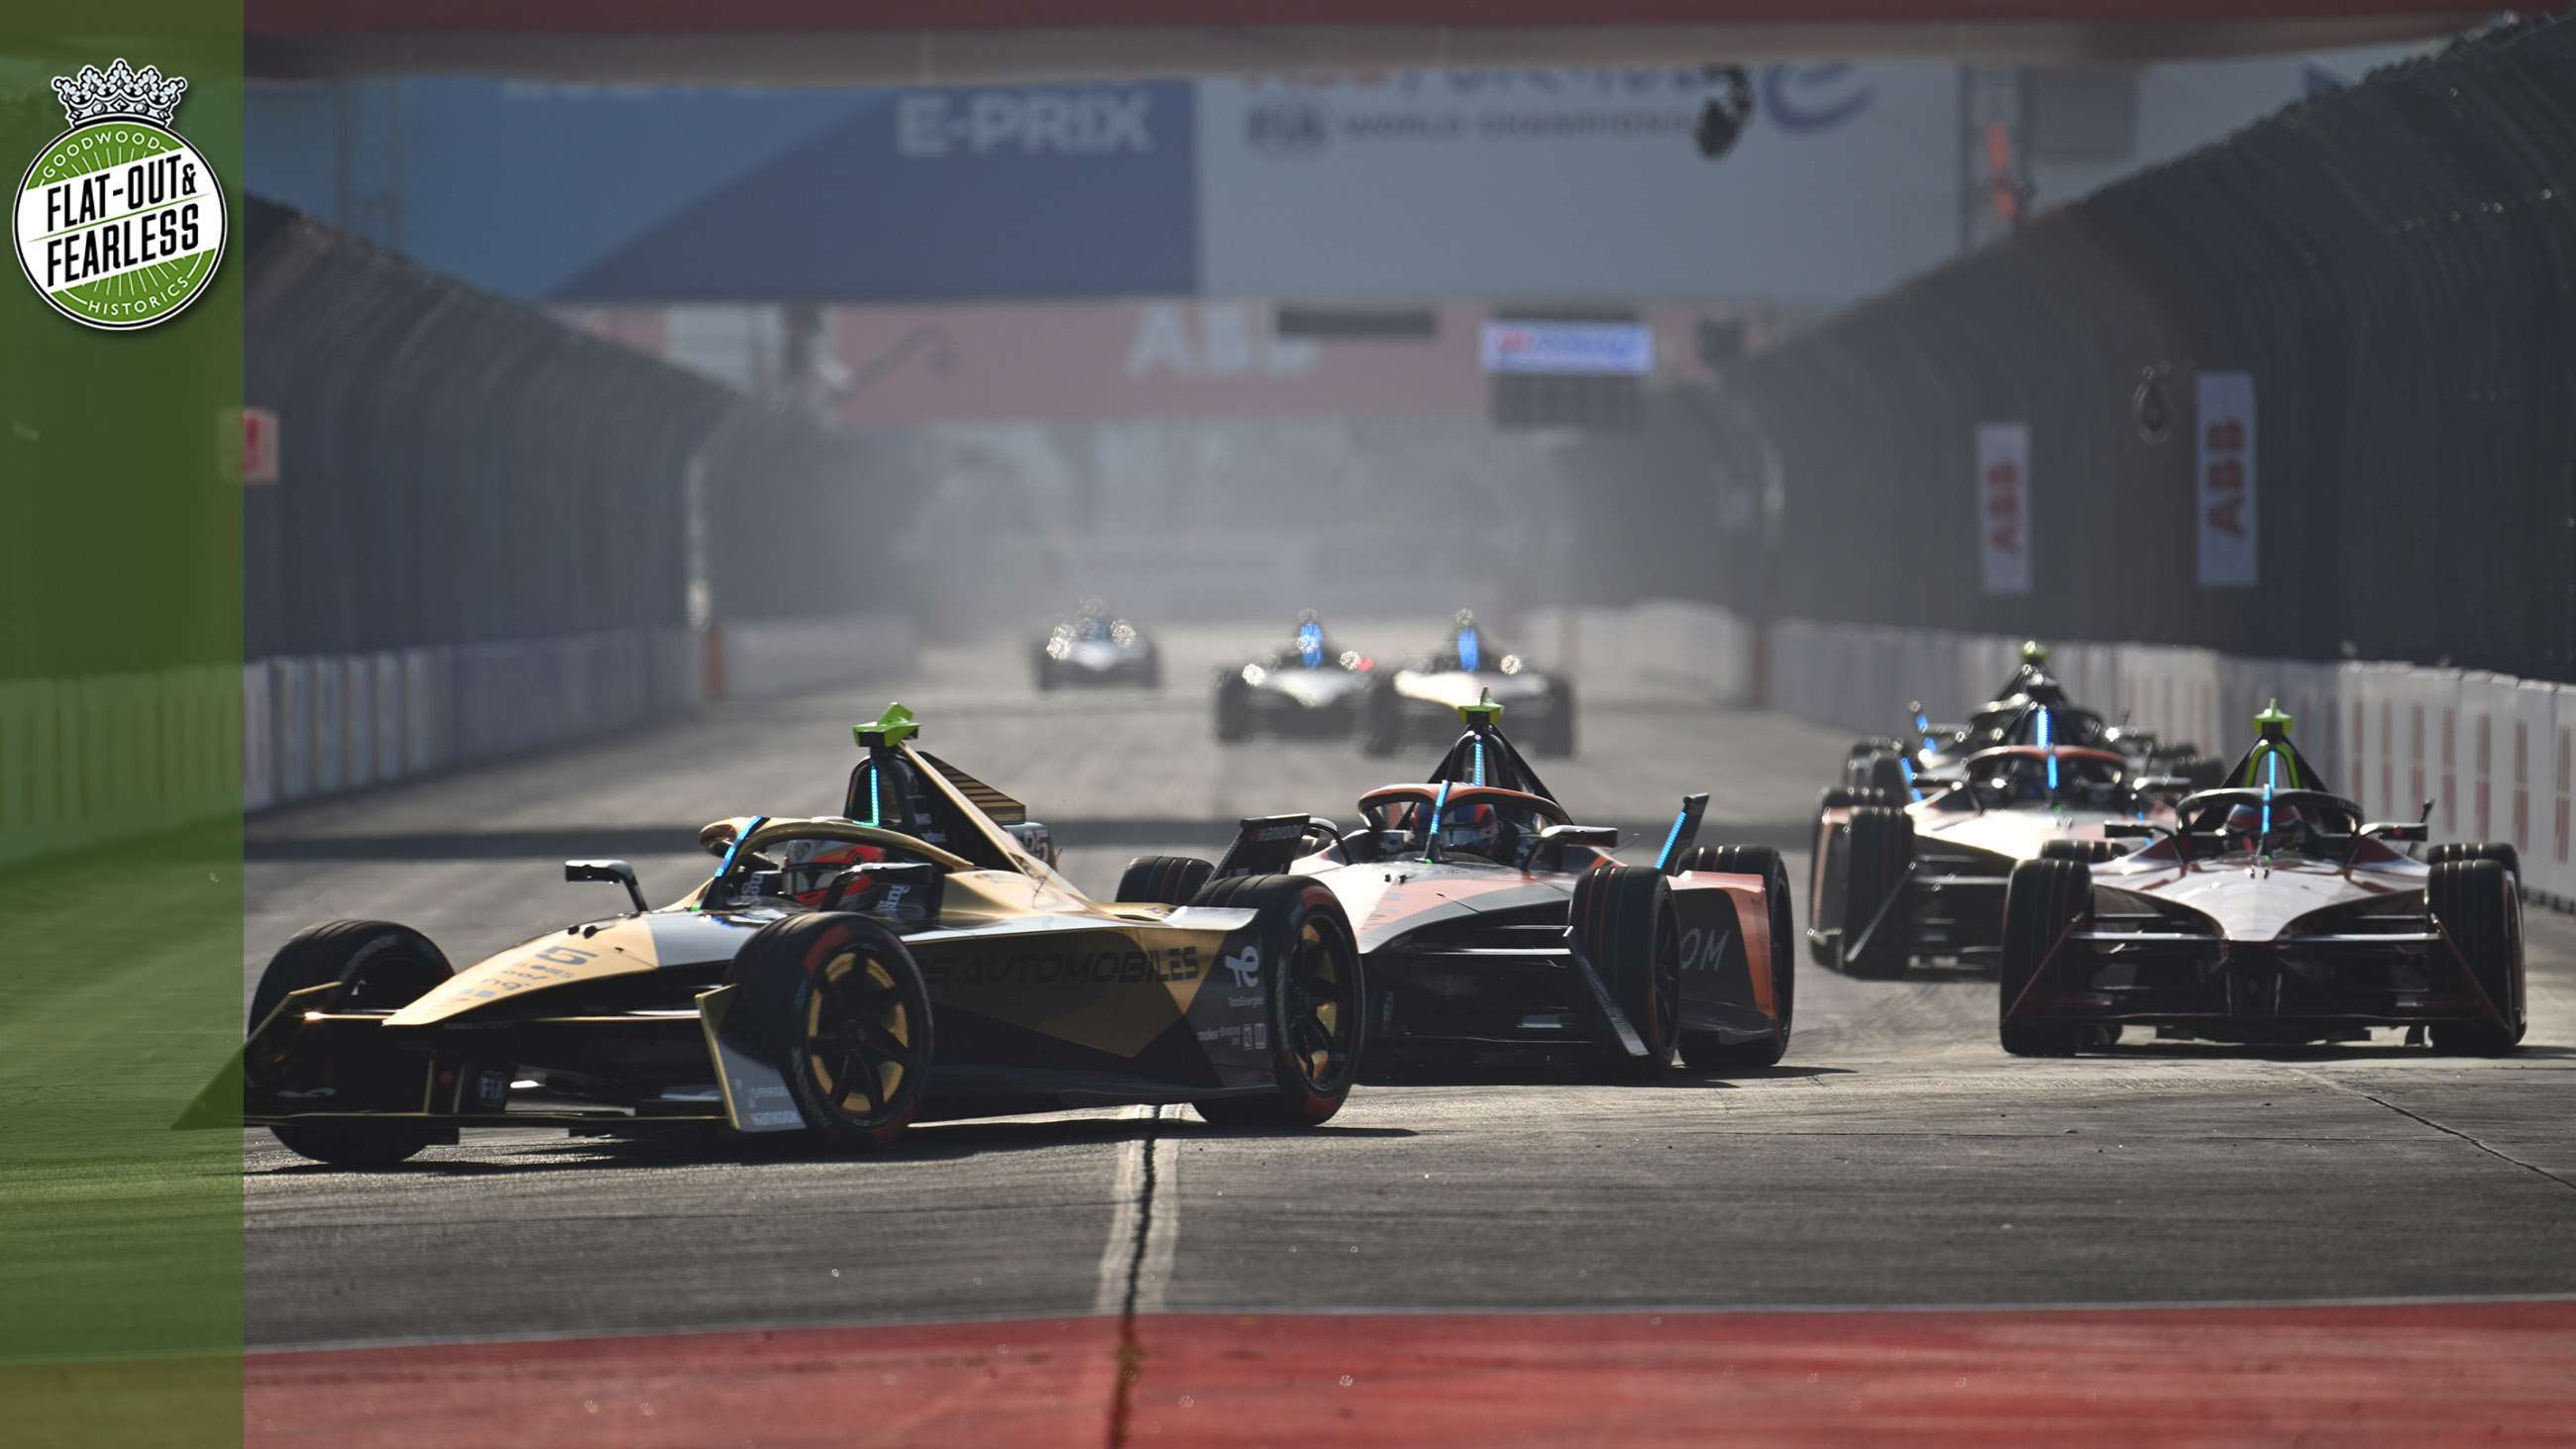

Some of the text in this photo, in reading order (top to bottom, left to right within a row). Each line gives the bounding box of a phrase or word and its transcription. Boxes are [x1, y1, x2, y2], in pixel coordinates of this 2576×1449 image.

[897, 92, 1153, 155] E-PRIX
[1986, 459, 2021, 556] ABB
[2204, 414, 2246, 540] ABB
[952, 946, 1200, 983] AUTOMOBILES
[1679, 926, 1731, 972] OM
